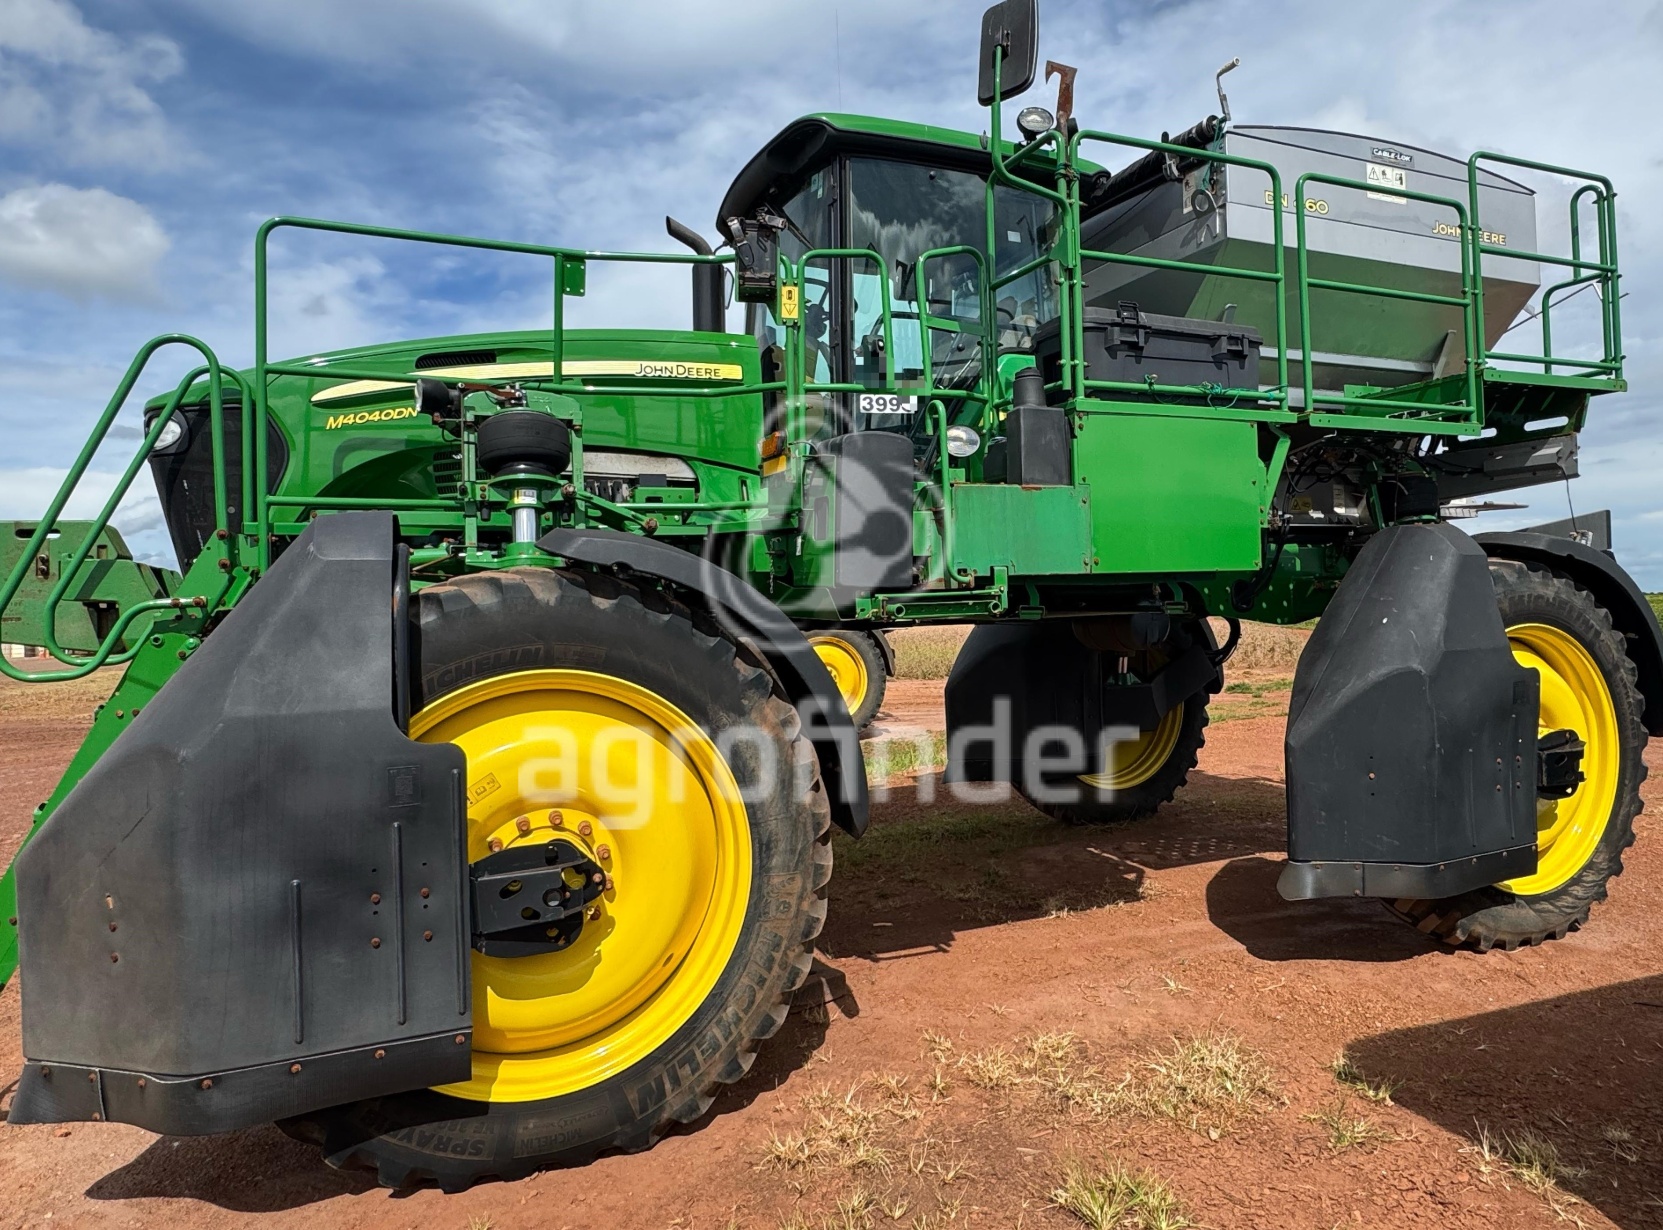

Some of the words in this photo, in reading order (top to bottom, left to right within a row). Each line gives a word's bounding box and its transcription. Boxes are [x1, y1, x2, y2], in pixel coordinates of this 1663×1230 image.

[1293, 198, 1330, 215] 60
[635, 363, 674, 376] JOHN
[676, 364, 722, 378] DEERE
[861, 395, 913, 413] 399
[325, 406, 419, 431] M4040DN
[424, 646, 544, 702] ICHELIN
